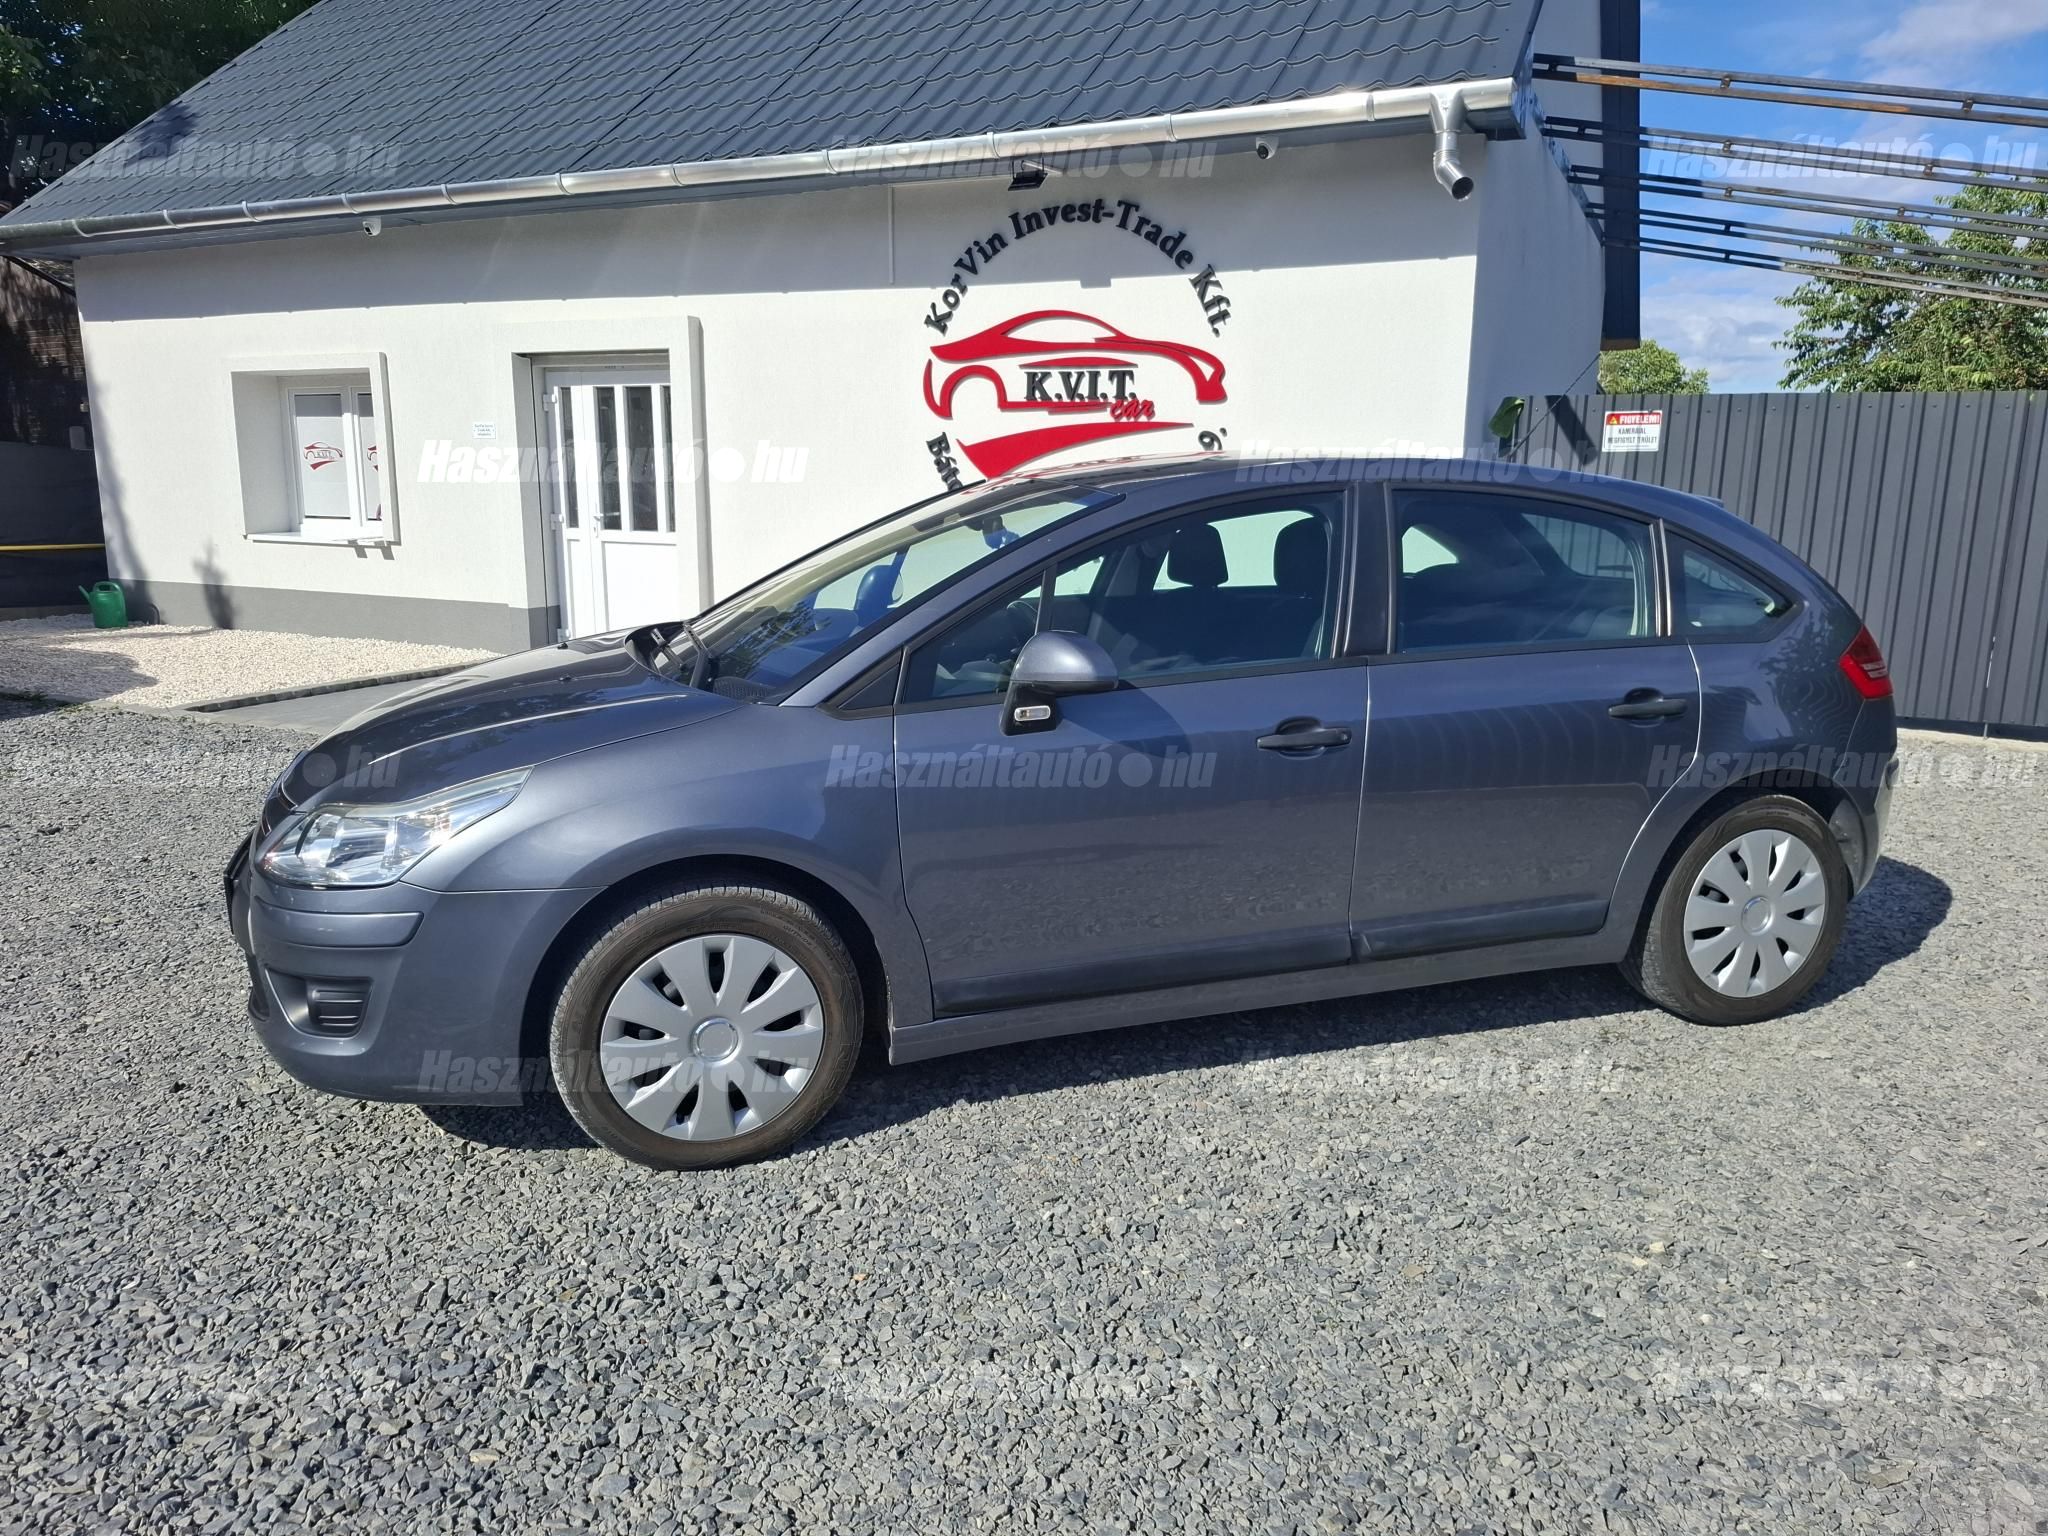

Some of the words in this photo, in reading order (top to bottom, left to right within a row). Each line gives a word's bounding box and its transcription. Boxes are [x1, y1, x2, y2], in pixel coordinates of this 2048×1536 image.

[1008, 199, 1193, 270] Invest-Trade
[1188, 264, 1231, 337] Kft.
[1024, 370, 1137, 402] K.V.I.T.
[1110, 398, 1155, 422] car
